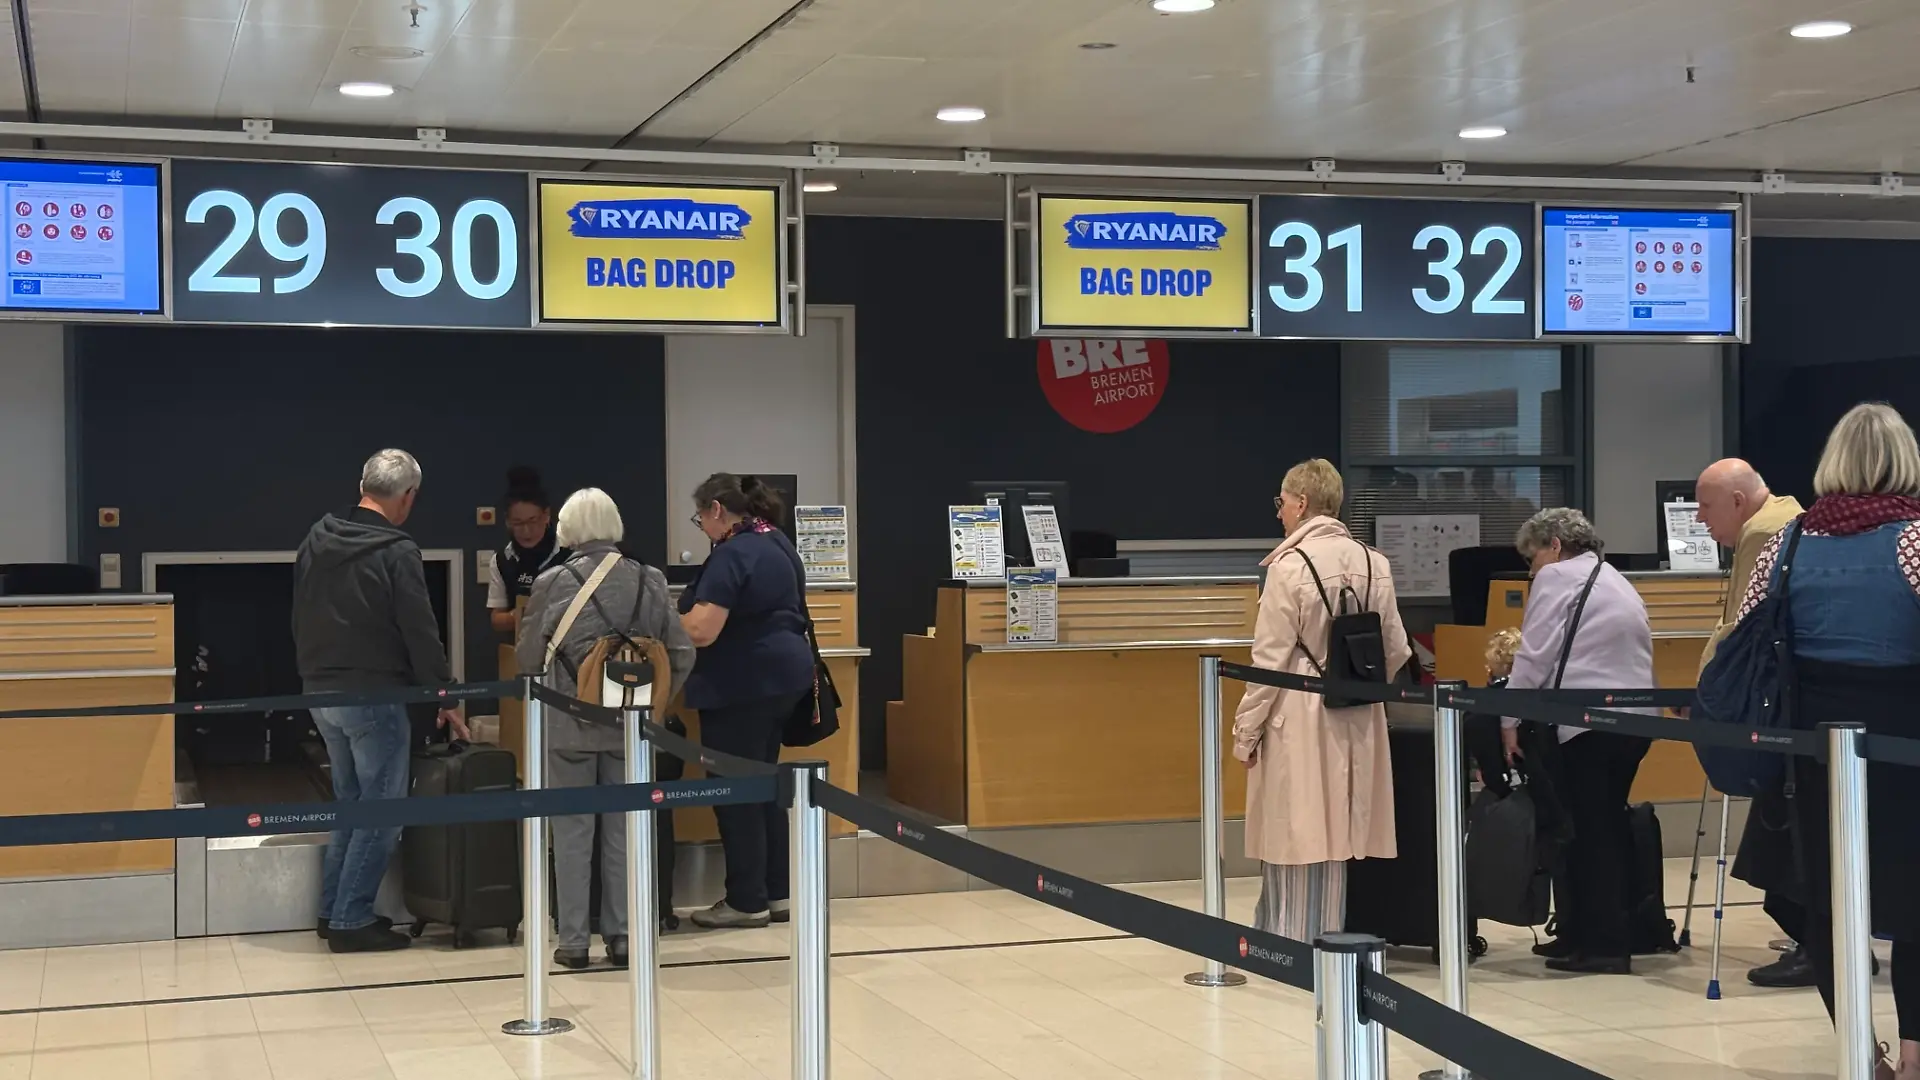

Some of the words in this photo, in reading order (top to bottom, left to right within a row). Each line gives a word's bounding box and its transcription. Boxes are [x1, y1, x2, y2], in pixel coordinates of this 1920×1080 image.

[600, 208, 740, 231] RYANAIR
[1093, 221, 1217, 243] RYANAIR
[185, 190, 327, 294] 29
[375, 196, 518, 300] 30
[586, 257, 647, 288] BAG
[655, 259, 735, 289] DROP
[1269, 221, 1363, 313] 31
[1412, 225, 1526, 315] 32
[1080, 267, 1133, 296] BAG
[1141, 268, 1212, 297] DROP
[1050, 339, 1150, 379] BRE
[1090, 366, 1153, 389] BREMEN
[1094, 382, 1155, 406] AIRPORT
[666, 789, 699, 799] BREMEN
[699, 787, 731, 797] AIRPORT
[264, 814, 300, 824] BREMEN
[301, 812, 337, 822] AIRPORT
[1248, 944, 1270, 960] BREMEN
[1270, 952, 1294, 967] AIRPORT
[1371, 991, 1398, 1013] AIRPORT
